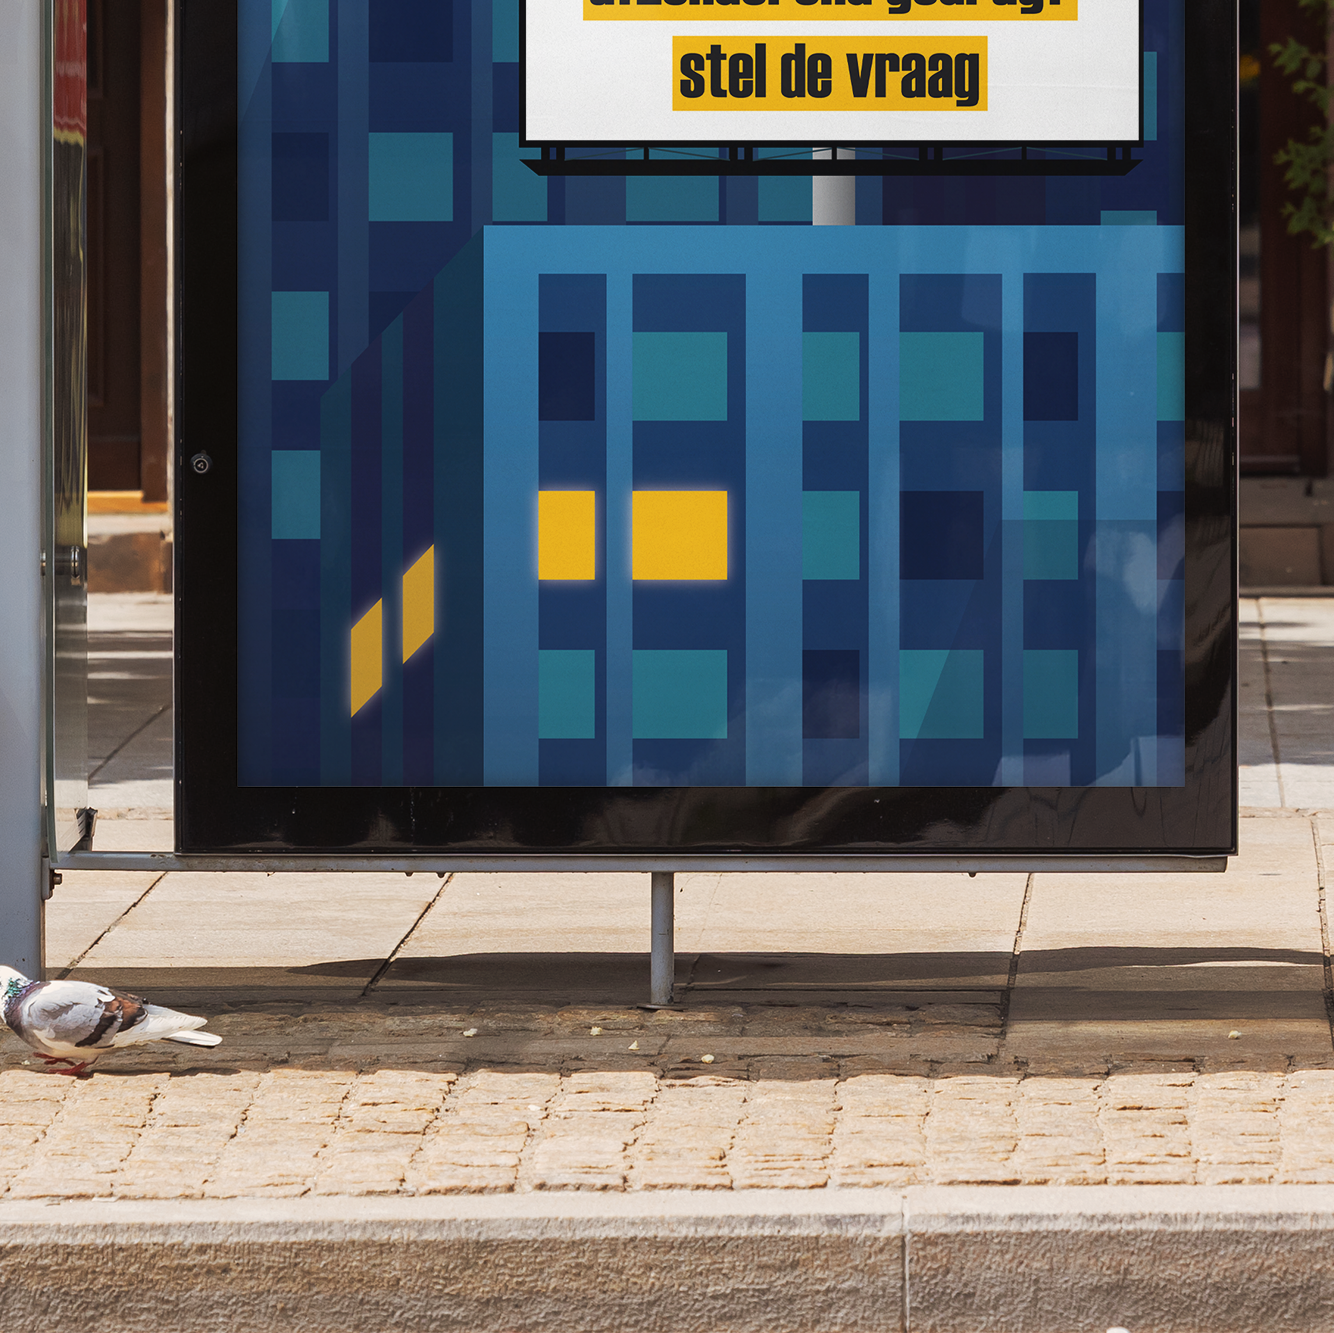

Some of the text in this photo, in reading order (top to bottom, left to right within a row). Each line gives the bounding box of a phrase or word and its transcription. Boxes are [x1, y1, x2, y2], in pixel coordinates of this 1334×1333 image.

[680, 43, 980, 107] stel de vraag
